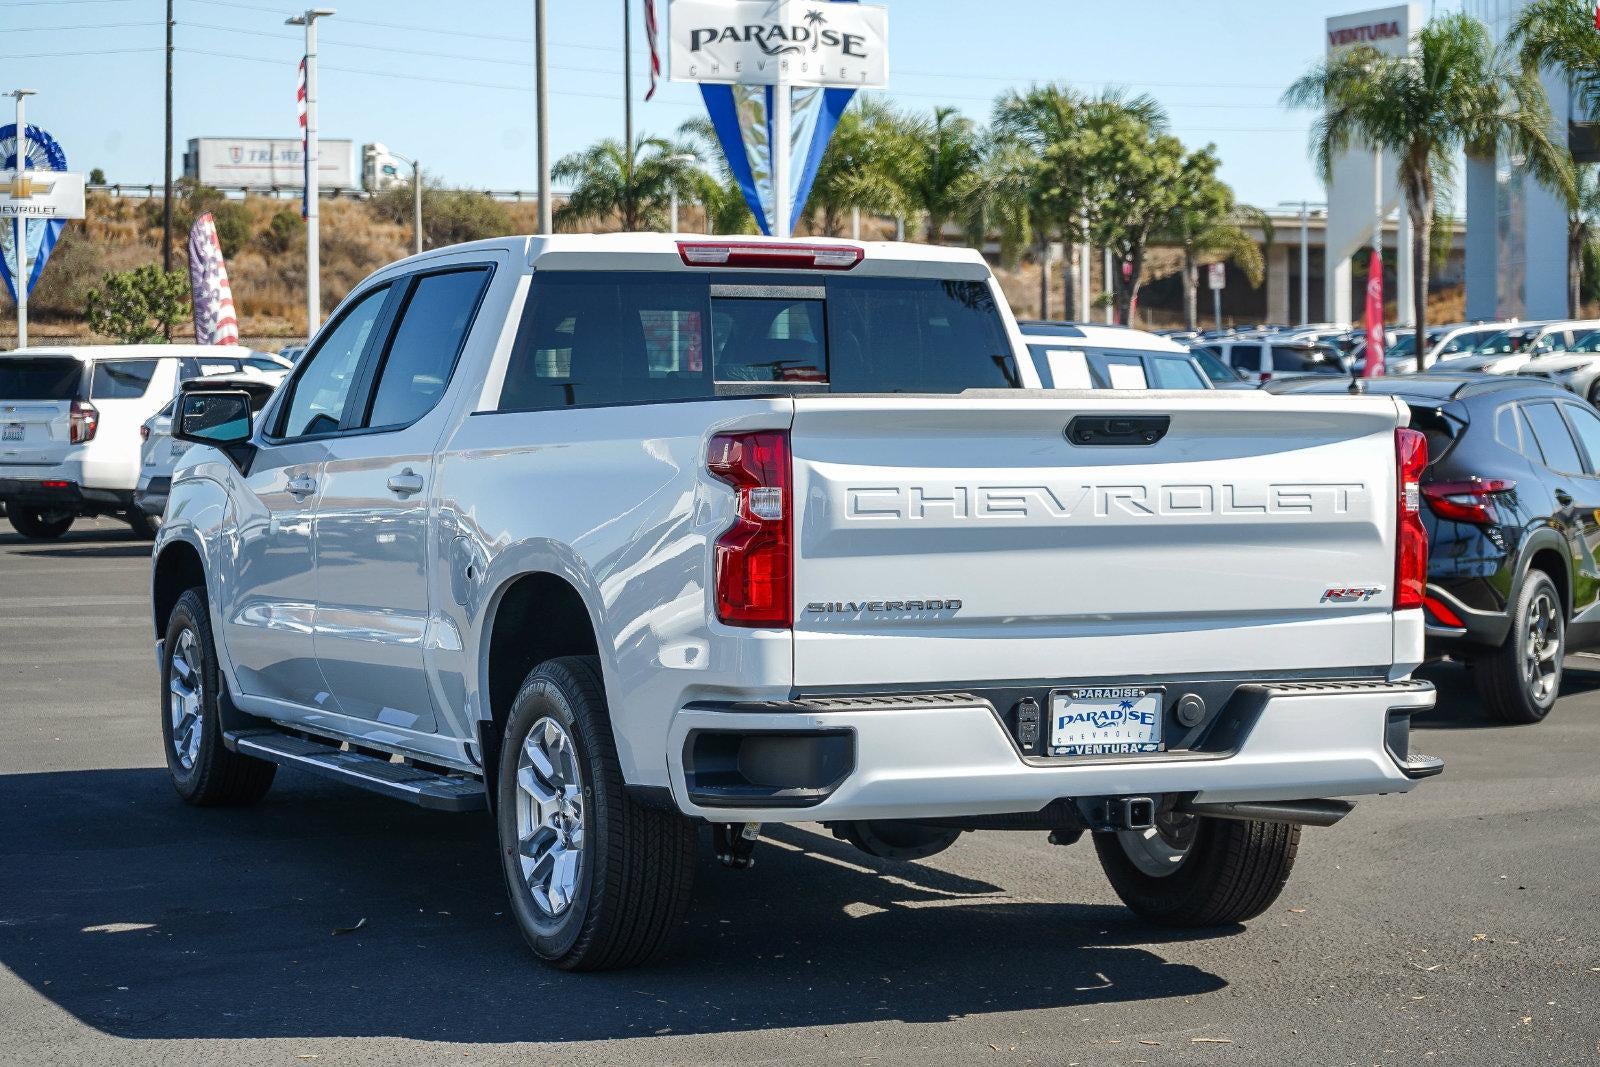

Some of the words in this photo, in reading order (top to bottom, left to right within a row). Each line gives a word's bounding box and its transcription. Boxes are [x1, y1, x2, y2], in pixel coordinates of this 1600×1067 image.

[690, 9, 867, 58] PARADISE
[1328, 21, 1400, 45] VENTURA
[688, 60, 868, 82] CHEVROLET
[0, 205, 57, 215] EVROLET
[844, 482, 1365, 522] CHEVROLET
[1321, 585, 1383, 600] RST
[807, 599, 963, 613] SILVERADO
[1078, 688, 1139, 699] PARADISE
[1058, 700, 1155, 729] PARADISE
[1057, 731, 1155, 744] CHEVROLET
[1076, 743, 1140, 755] VENTURA
